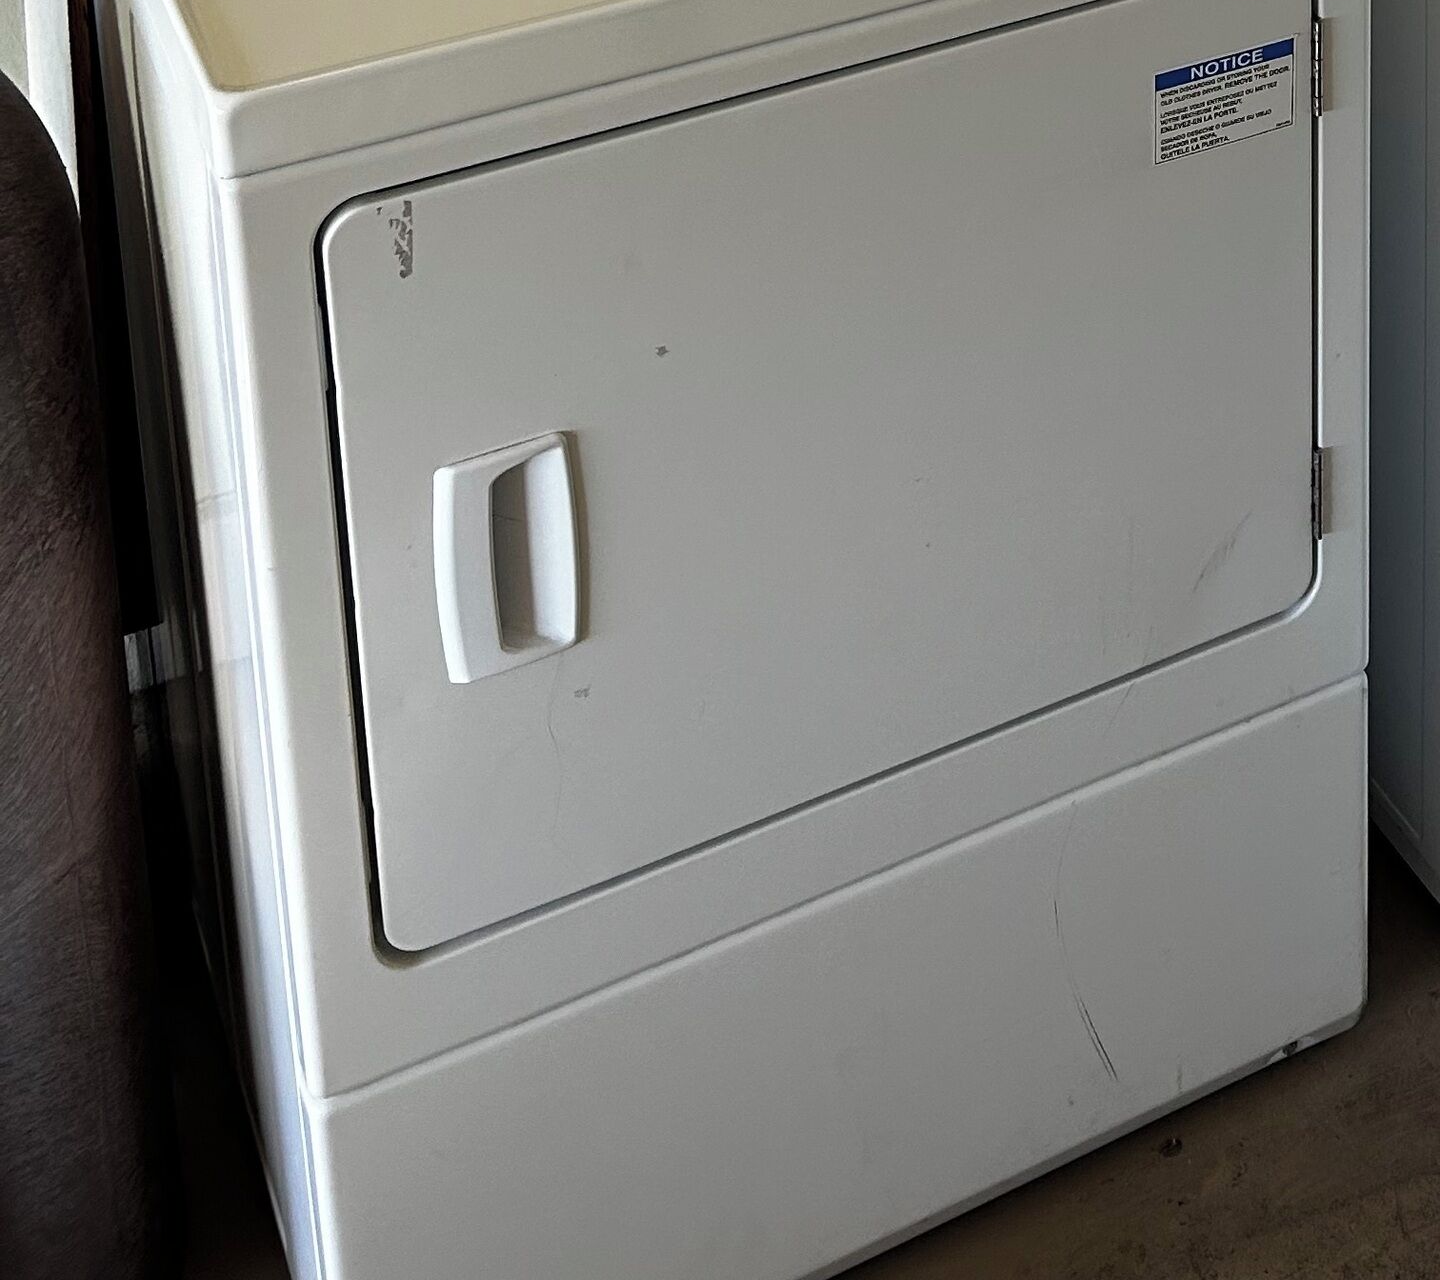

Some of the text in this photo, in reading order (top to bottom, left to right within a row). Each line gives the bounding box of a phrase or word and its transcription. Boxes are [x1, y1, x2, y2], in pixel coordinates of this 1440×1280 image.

[1190, 48, 1264, 80] NOTICE
[1225, 75, 1252, 88] REMOVE
[1254, 71, 1267, 80] THE
[1191, 143, 1199, 151] LA
